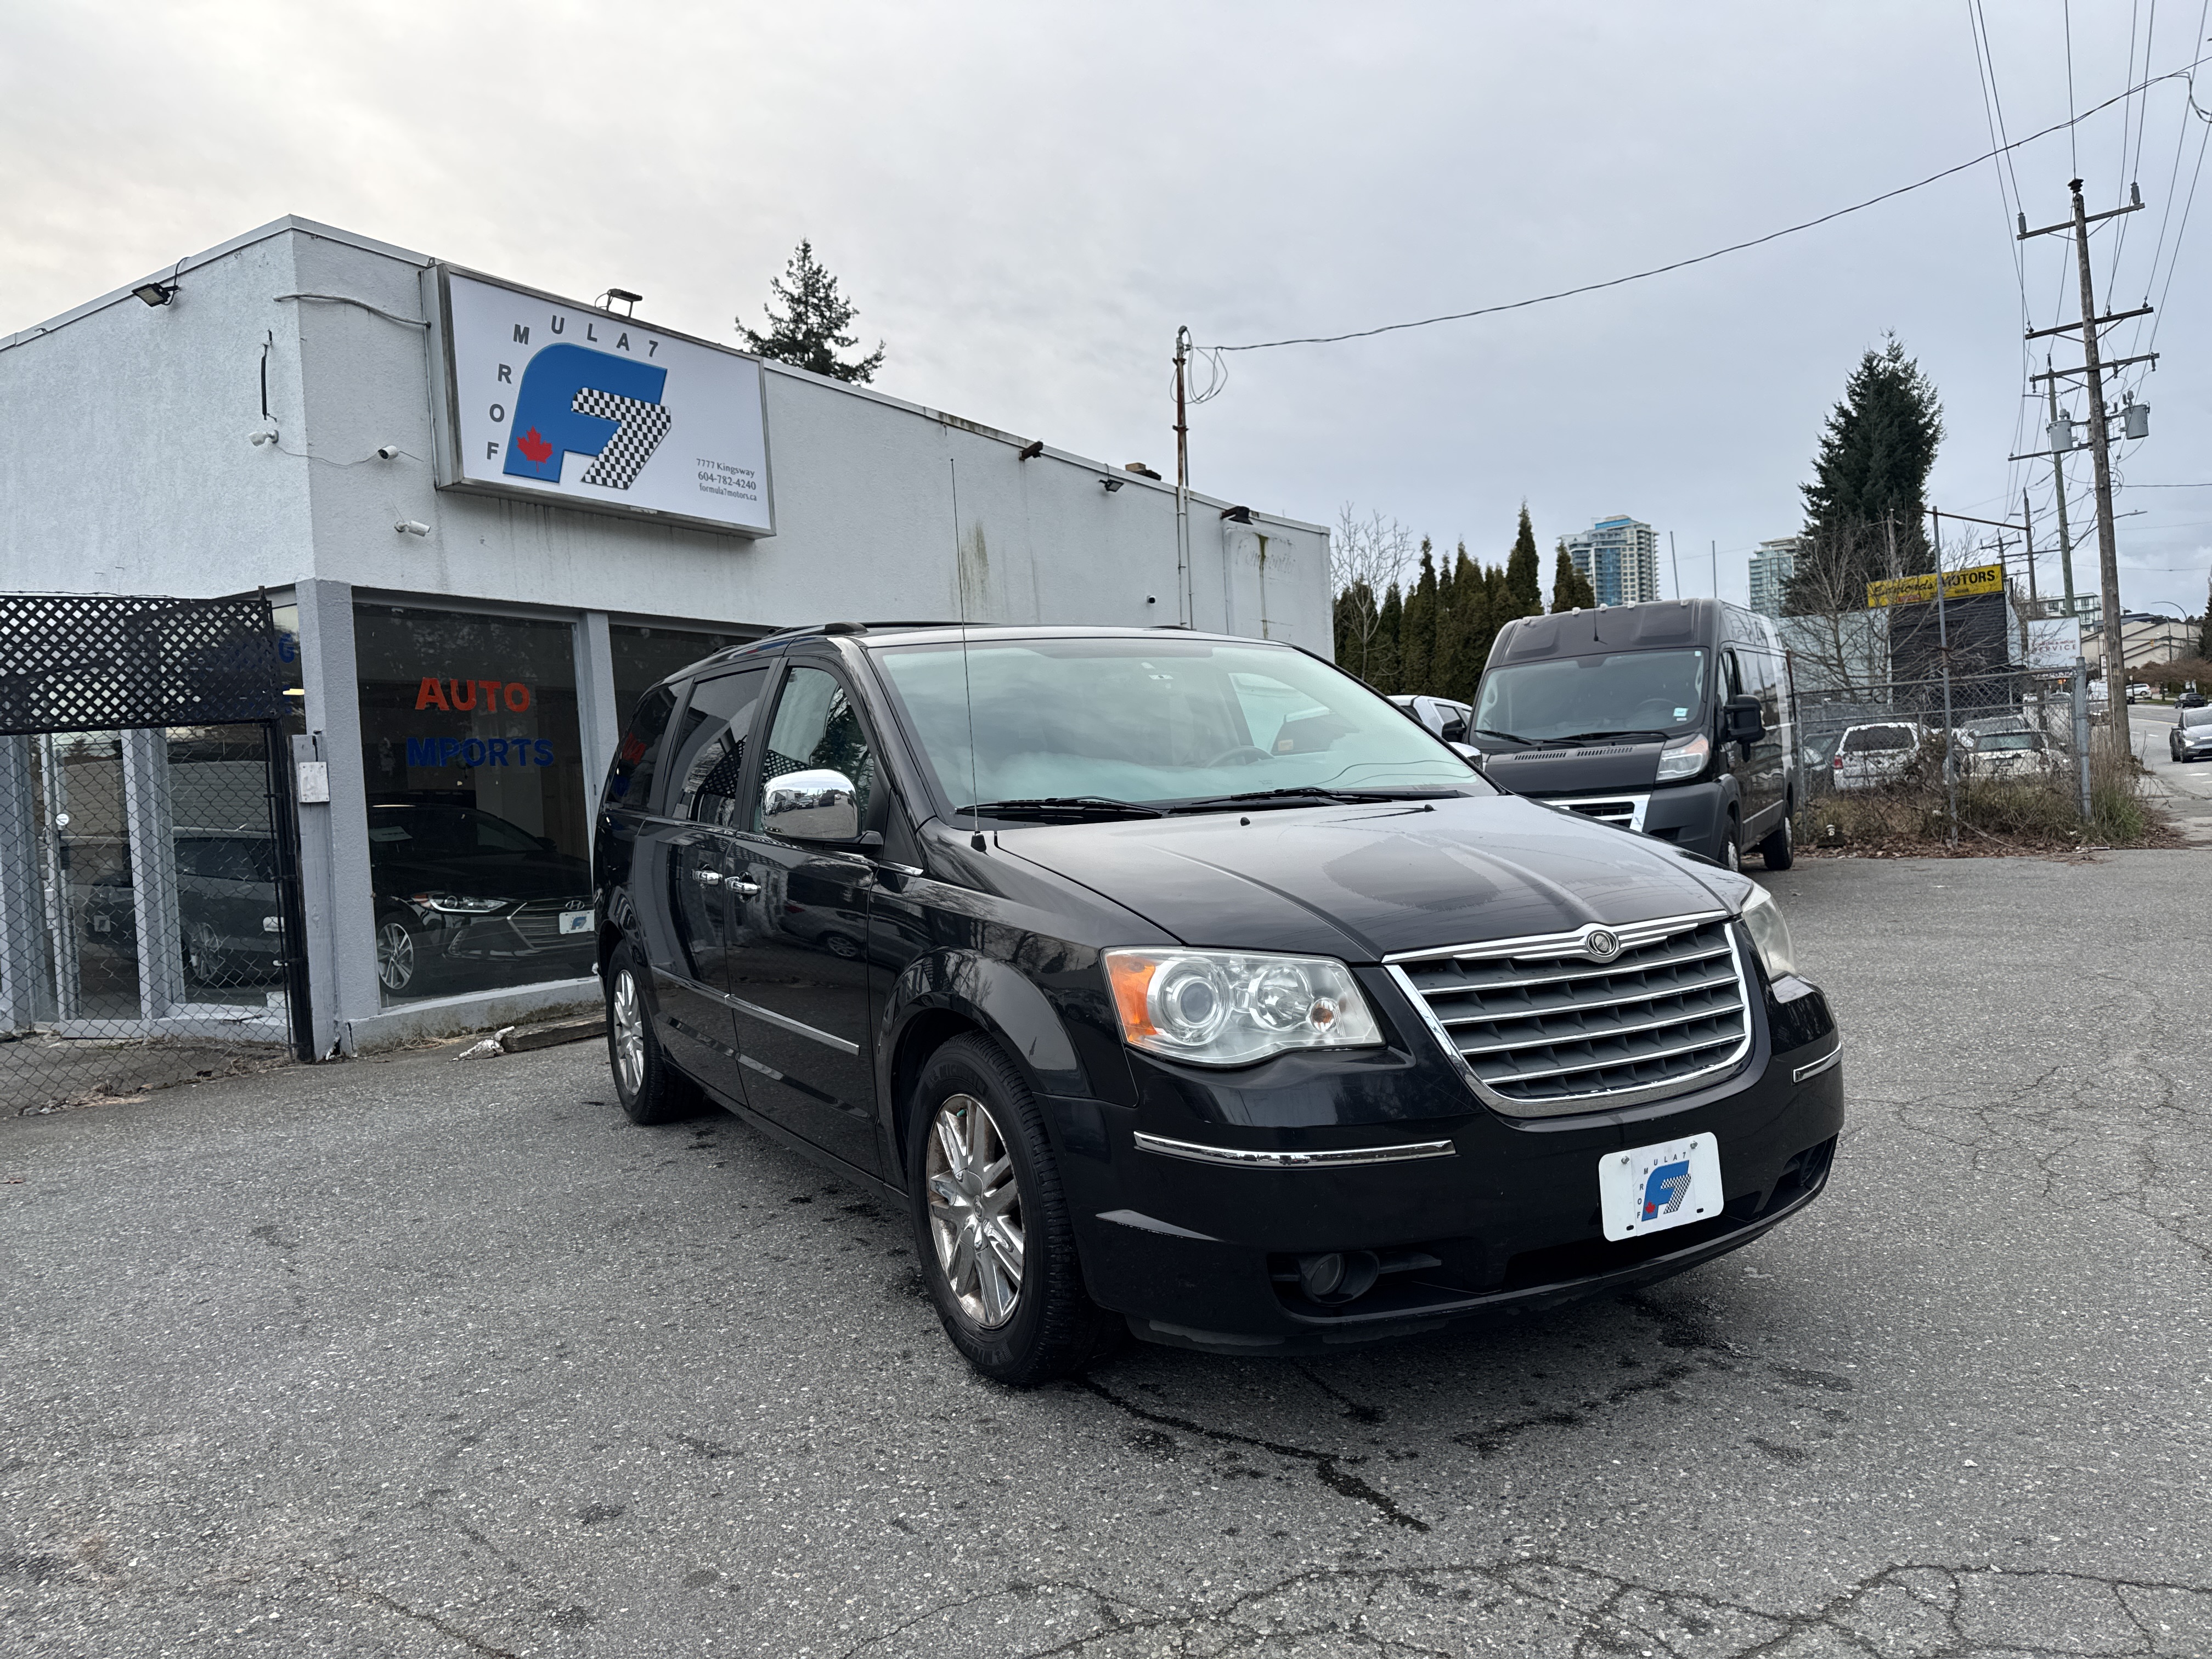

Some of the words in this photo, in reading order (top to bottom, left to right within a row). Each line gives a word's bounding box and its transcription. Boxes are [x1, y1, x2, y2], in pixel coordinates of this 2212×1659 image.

[696, 458, 715, 469] 7777
[716, 462, 755, 478] Kingsway
[698, 471, 756, 490] 604-782-4240
[699, 483, 757, 501] formula7motors.ca
[415, 676, 531, 712] AUTO
[407, 737, 554, 767] MPORTS
